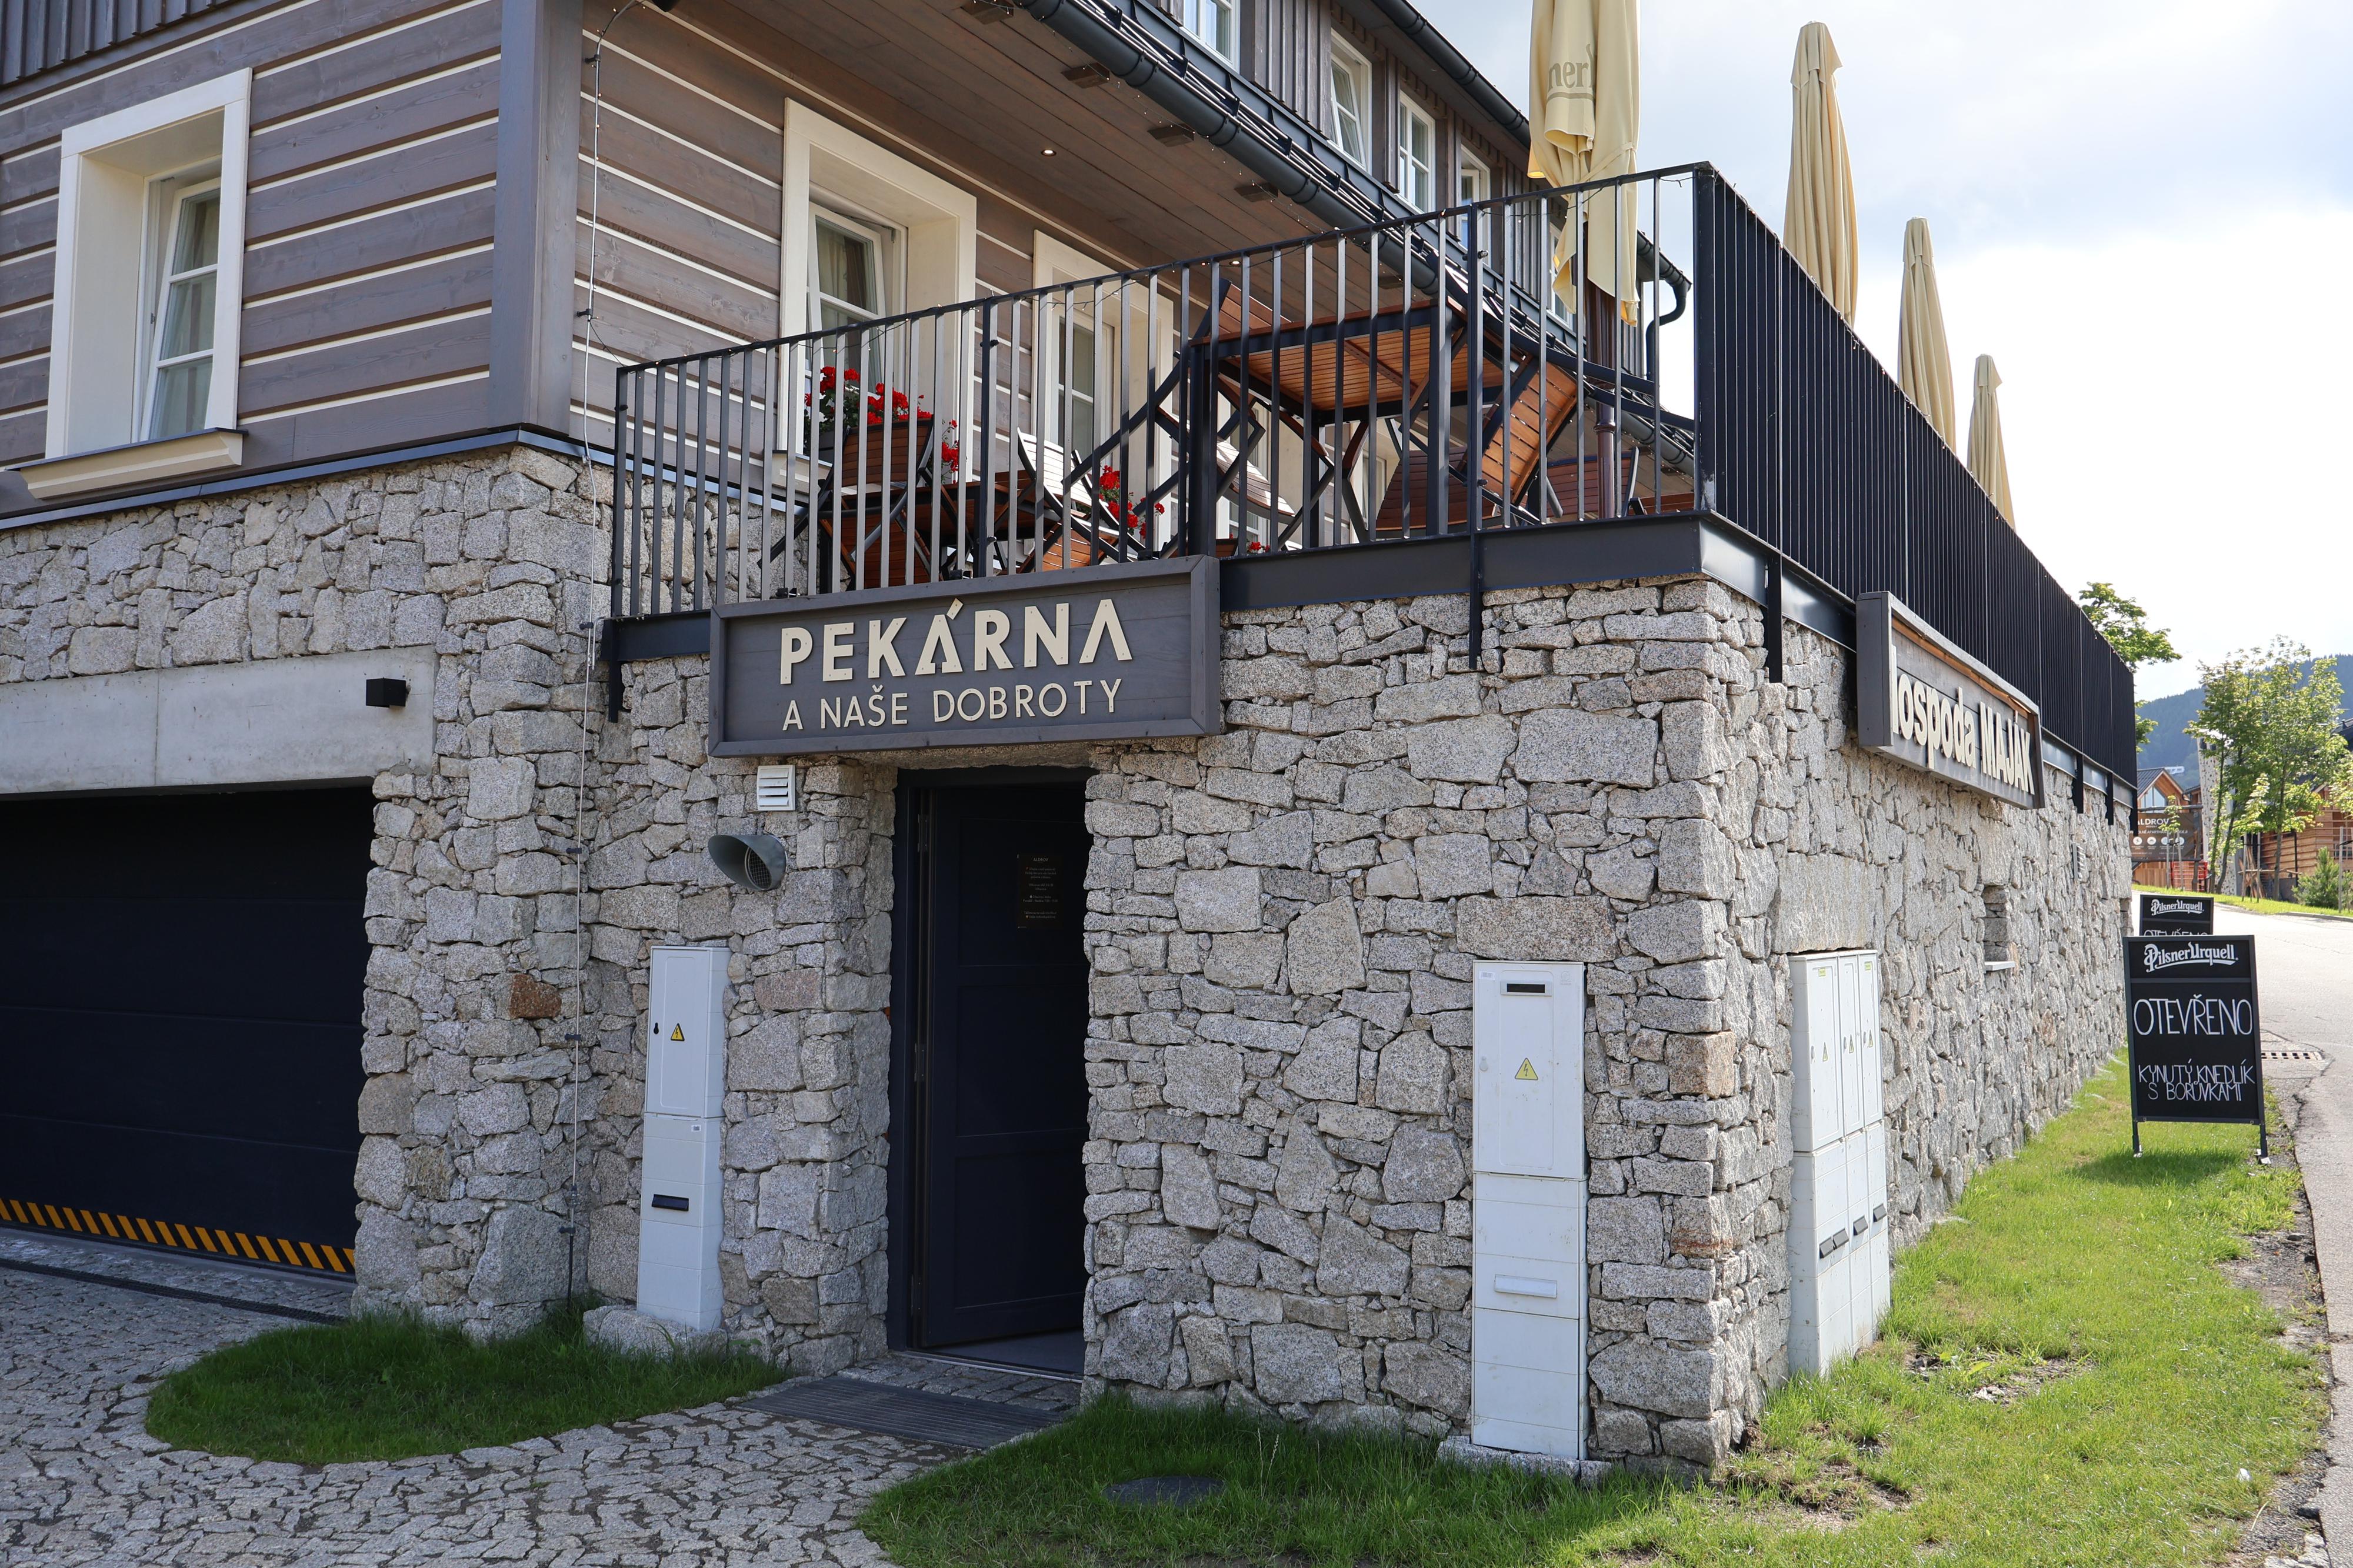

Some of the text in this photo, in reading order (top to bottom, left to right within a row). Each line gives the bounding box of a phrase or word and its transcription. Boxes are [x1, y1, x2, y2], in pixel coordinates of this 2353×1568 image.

[780, 598, 1133, 685] PEKÁRNA
[782, 678, 1122, 731] A NAŠE DOBROTY
[1979, 700, 2035, 796] MAJÁK
[2151, 899, 2203, 916] Pilsner Urquell
[2144, 941, 2236, 973] Pilsner Urquell
[2134, 994, 2252, 1035] OTEVŘENO
[2138, 1058, 2255, 1084] KYNUTÝ KNEDLÍK
[2148, 1080, 2242, 1102] S BORŮVKAMI
